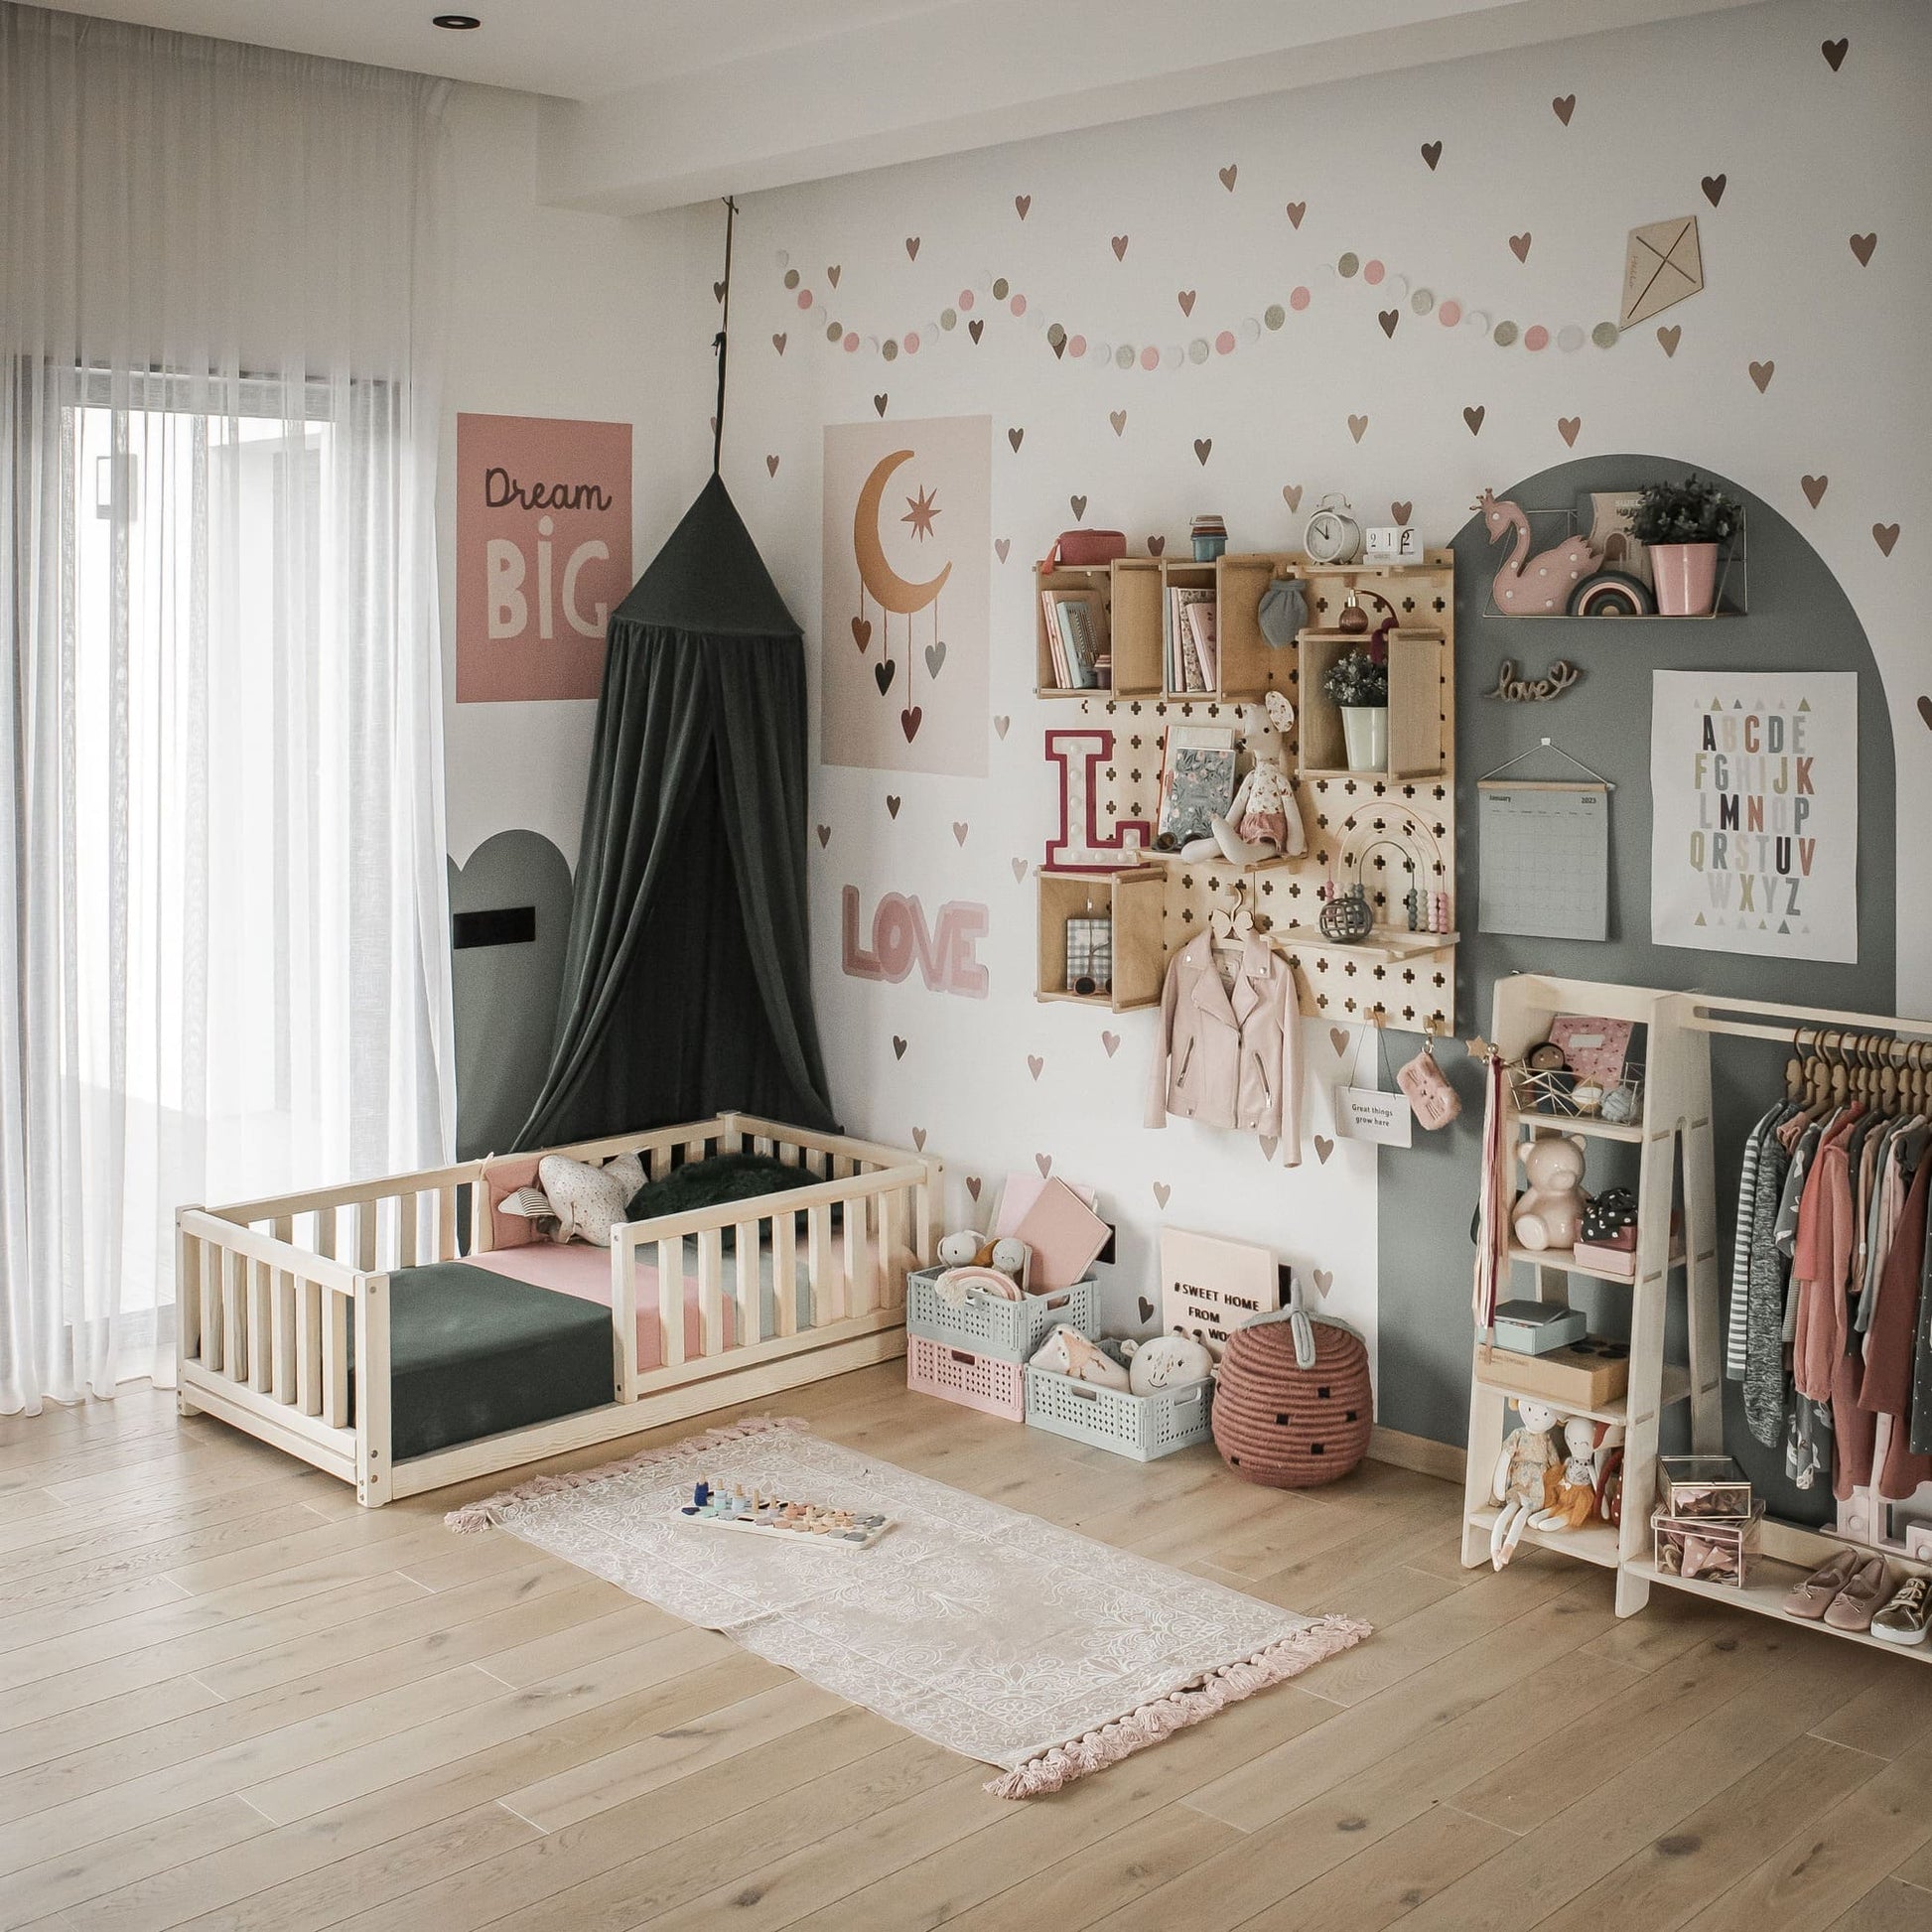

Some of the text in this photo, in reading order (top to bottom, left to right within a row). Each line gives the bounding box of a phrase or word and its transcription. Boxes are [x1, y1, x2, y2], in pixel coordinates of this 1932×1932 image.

[485, 468, 613, 511] Dream
[1483, 660, 1579, 703] love
[1045, 730, 1151, 873] L
[842, 884, 989, 1000] LOVE
[1351, 1103, 1393, 1117] Great things
[1374, 1117, 1390, 1127] here
[1224, 1294, 1259, 1311] HOME
[1188, 1306, 1220, 1323] FROM
[1207, 1327, 1230, 1342] WO
